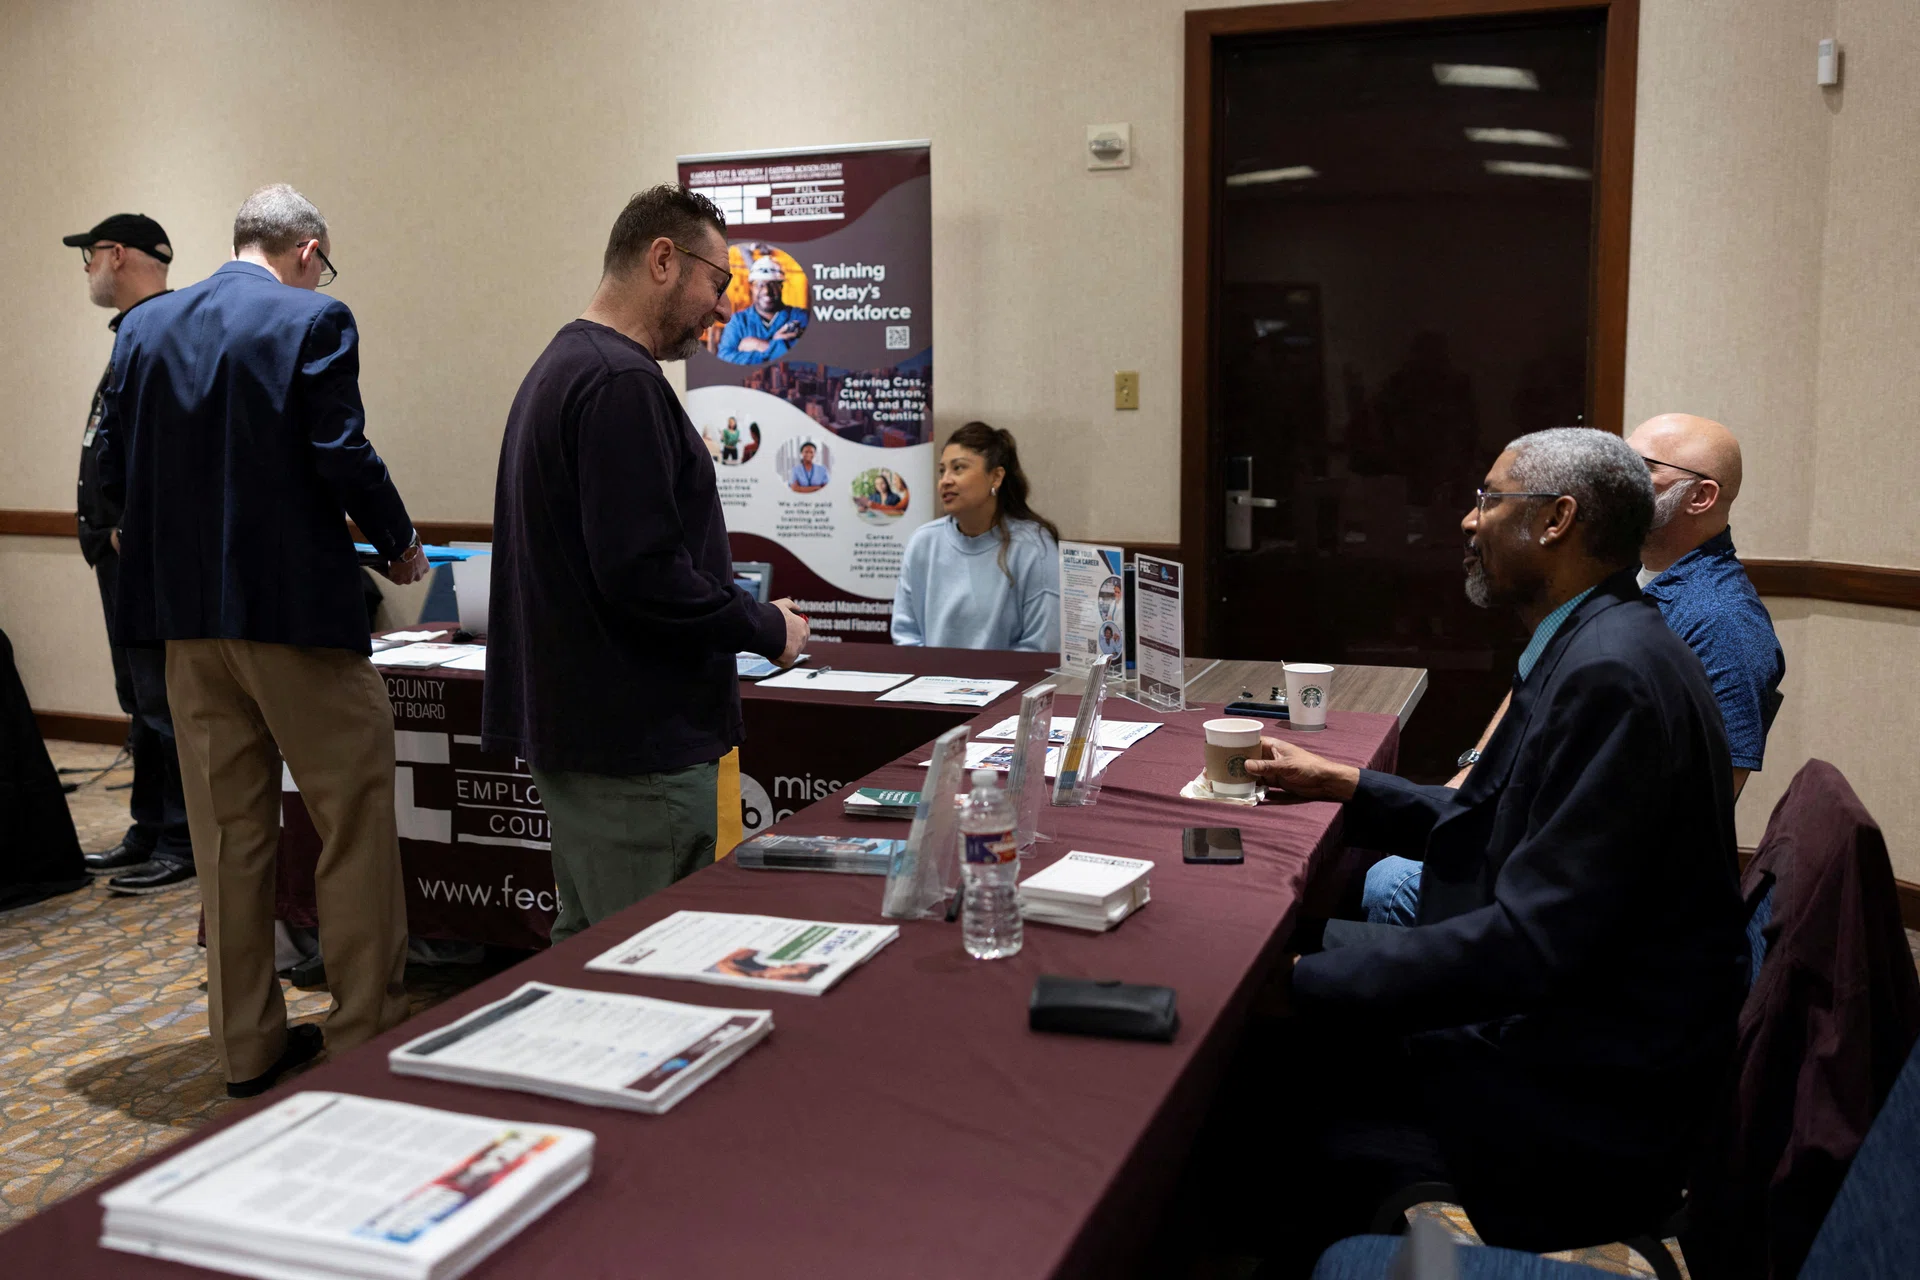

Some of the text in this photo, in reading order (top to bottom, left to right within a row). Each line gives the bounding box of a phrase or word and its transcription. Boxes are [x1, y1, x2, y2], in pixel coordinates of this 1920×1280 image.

[716, 170, 730, 178] CITY
[772, 195, 843, 206] EMPLOYMENT
[784, 207, 832, 216] COUNCIL
[812, 262, 885, 282] Training
[812, 283, 881, 303] Today's
[813, 304, 912, 322] Workforce
[845, 377, 926, 389] Serving Cass,
[840, 388, 926, 400] Clay, Jackson,
[838, 400, 926, 411] Platte and Ray
[873, 411, 926, 421] Counties
[781, 516, 811, 524] training
[833, 618, 850, 630] and
[852, 618, 888, 632] Finance
[387, 678, 445, 701] COUNTY
[406, 702, 445, 720] BOARD
[489, 814, 551, 839] COU
